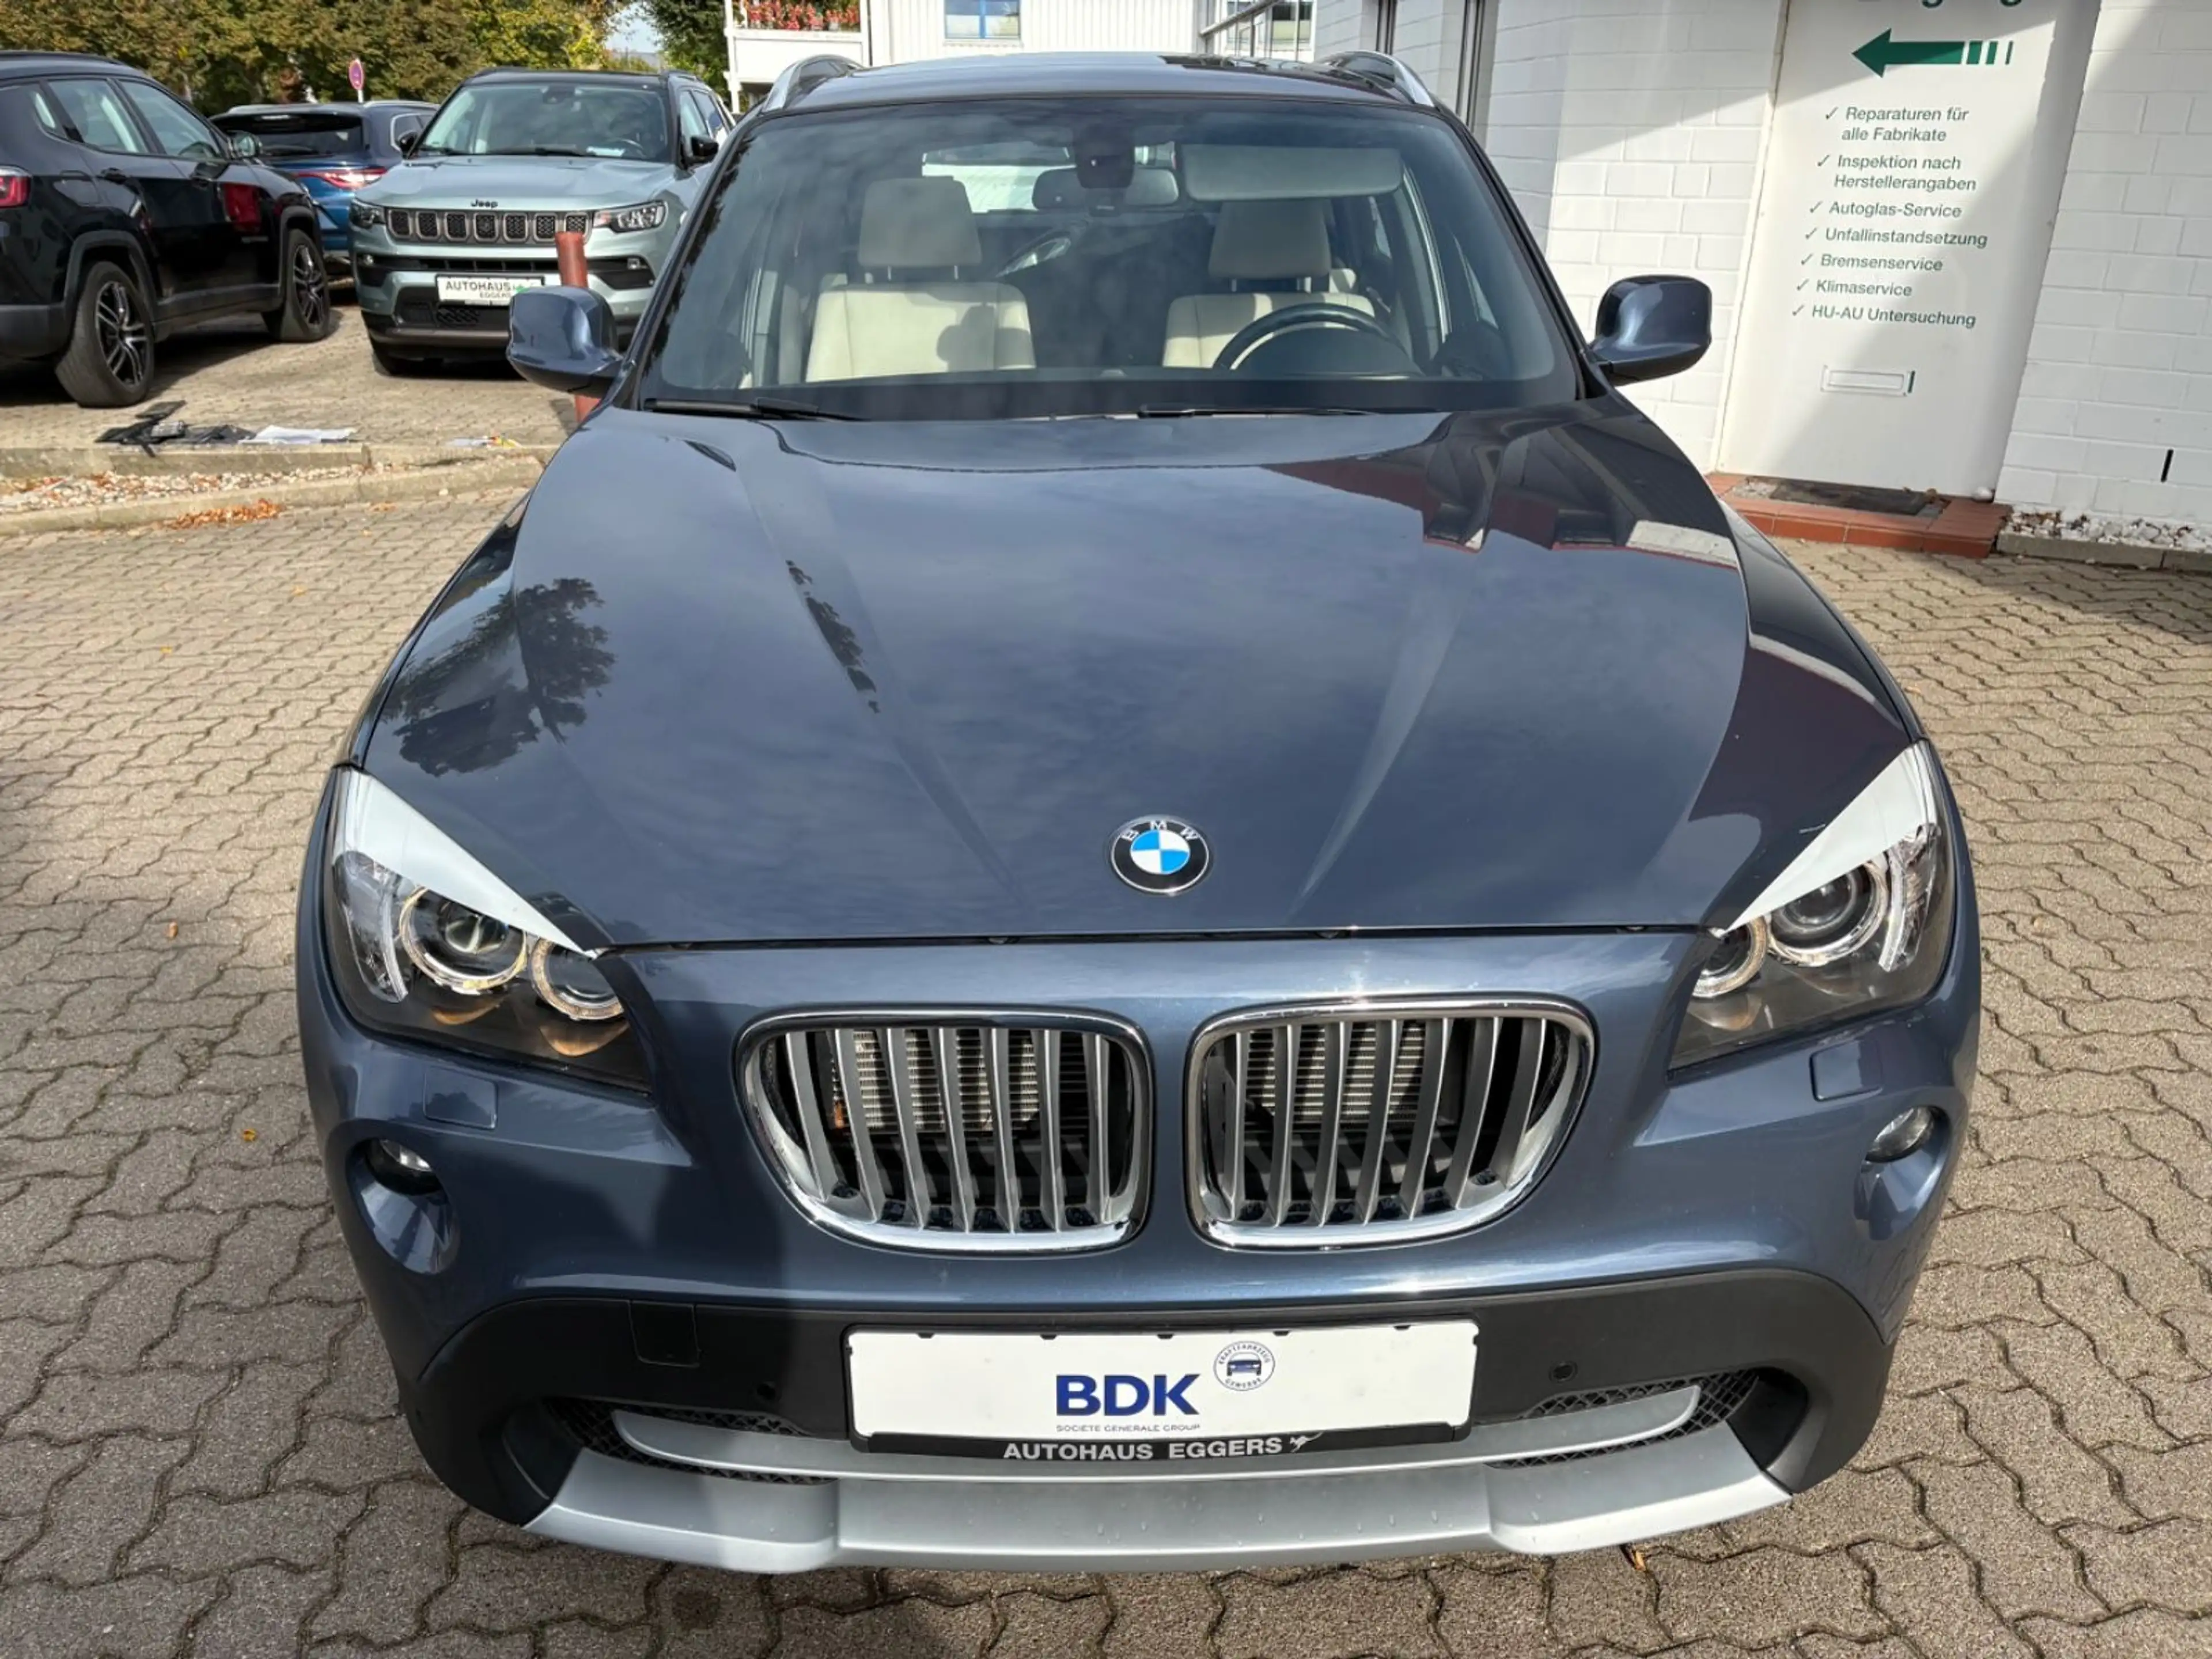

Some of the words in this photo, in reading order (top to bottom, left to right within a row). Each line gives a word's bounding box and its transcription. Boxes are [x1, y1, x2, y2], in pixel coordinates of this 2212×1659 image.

[1846, 107, 1942, 123] Reparaturen
[1946, 107, 1969, 120] für
[1842, 127, 1868, 141] alle
[1873, 127, 1947, 142] Fabrikate
[1838, 155, 1918, 171] Inspektion
[1922, 156, 1961, 169] nach
[1834, 175, 1976, 192] Herstellerangaben
[471, 199, 498, 208] Jeep
[1829, 202, 1963, 218] Autoglas-Service
[1825, 228, 1988, 248] Unfallinstandsetzung
[1821, 254, 1942, 271] Bremsenservice
[446, 281, 510, 291] AUTOHAUS
[1816, 280, 1912, 297] Klimaservice
[1812, 305, 1863, 320] HU-AU
[1868, 308, 1976, 328] Untersuchung
[1121, 820, 1199, 841] BMW
[1056, 1374, 1200, 1416] BDK
[1163, 1423, 1200, 1431] GROUP
[1003, 1442, 1153, 1460] AUTOHAUS
[1169, 1437, 1282, 1459] EGGERS
